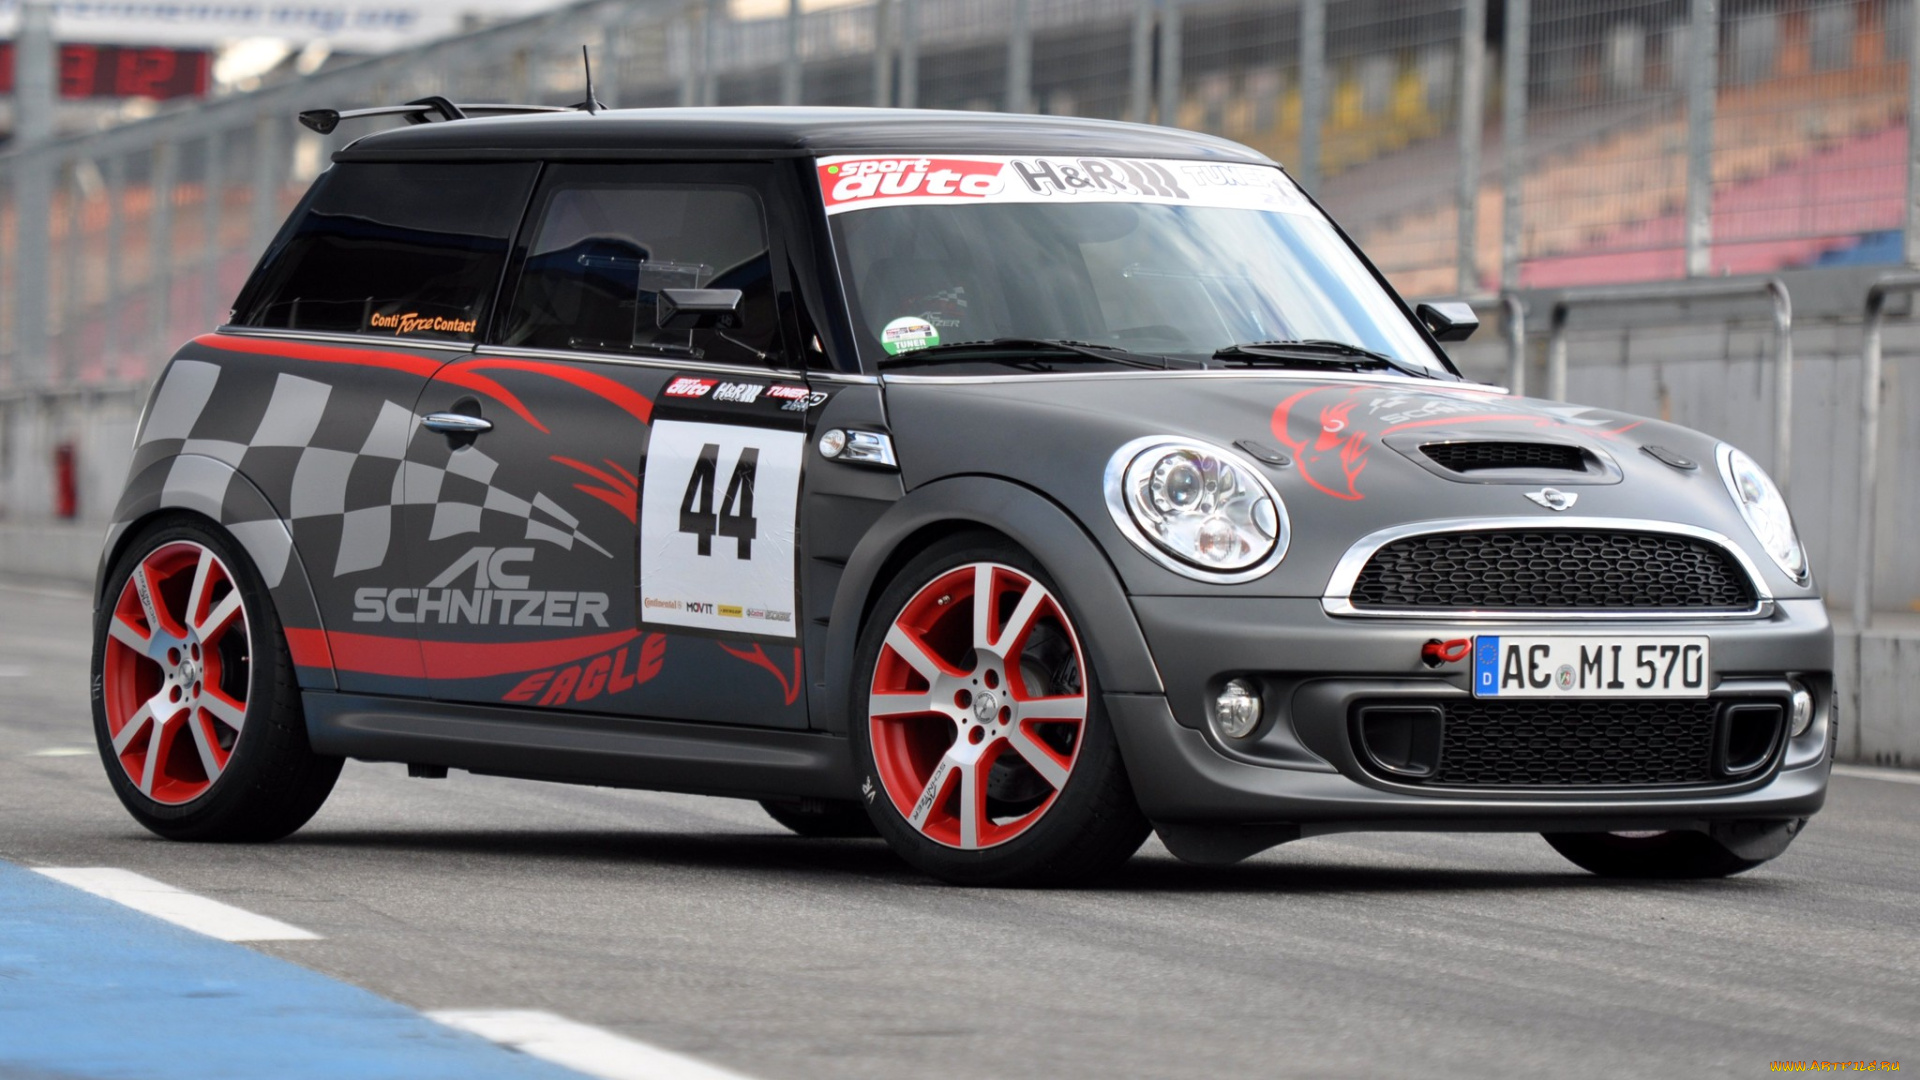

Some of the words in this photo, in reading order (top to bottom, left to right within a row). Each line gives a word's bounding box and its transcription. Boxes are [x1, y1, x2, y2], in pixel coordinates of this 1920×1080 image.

[832, 170, 1005, 201] auto
[839, 159, 931, 177] sport
[1010, 158, 1138, 195] H&R
[679, 443, 760, 561] 44
[425, 546, 536, 589] AC
[352, 587, 610, 627] SCHNITZER
[501, 632, 667, 706] EAGLE
[1482, 672, 1492, 686] D
[1501, 644, 1552, 689] AC
[1579, 644, 1625, 689] MI
[1635, 644, 1703, 689] 570
